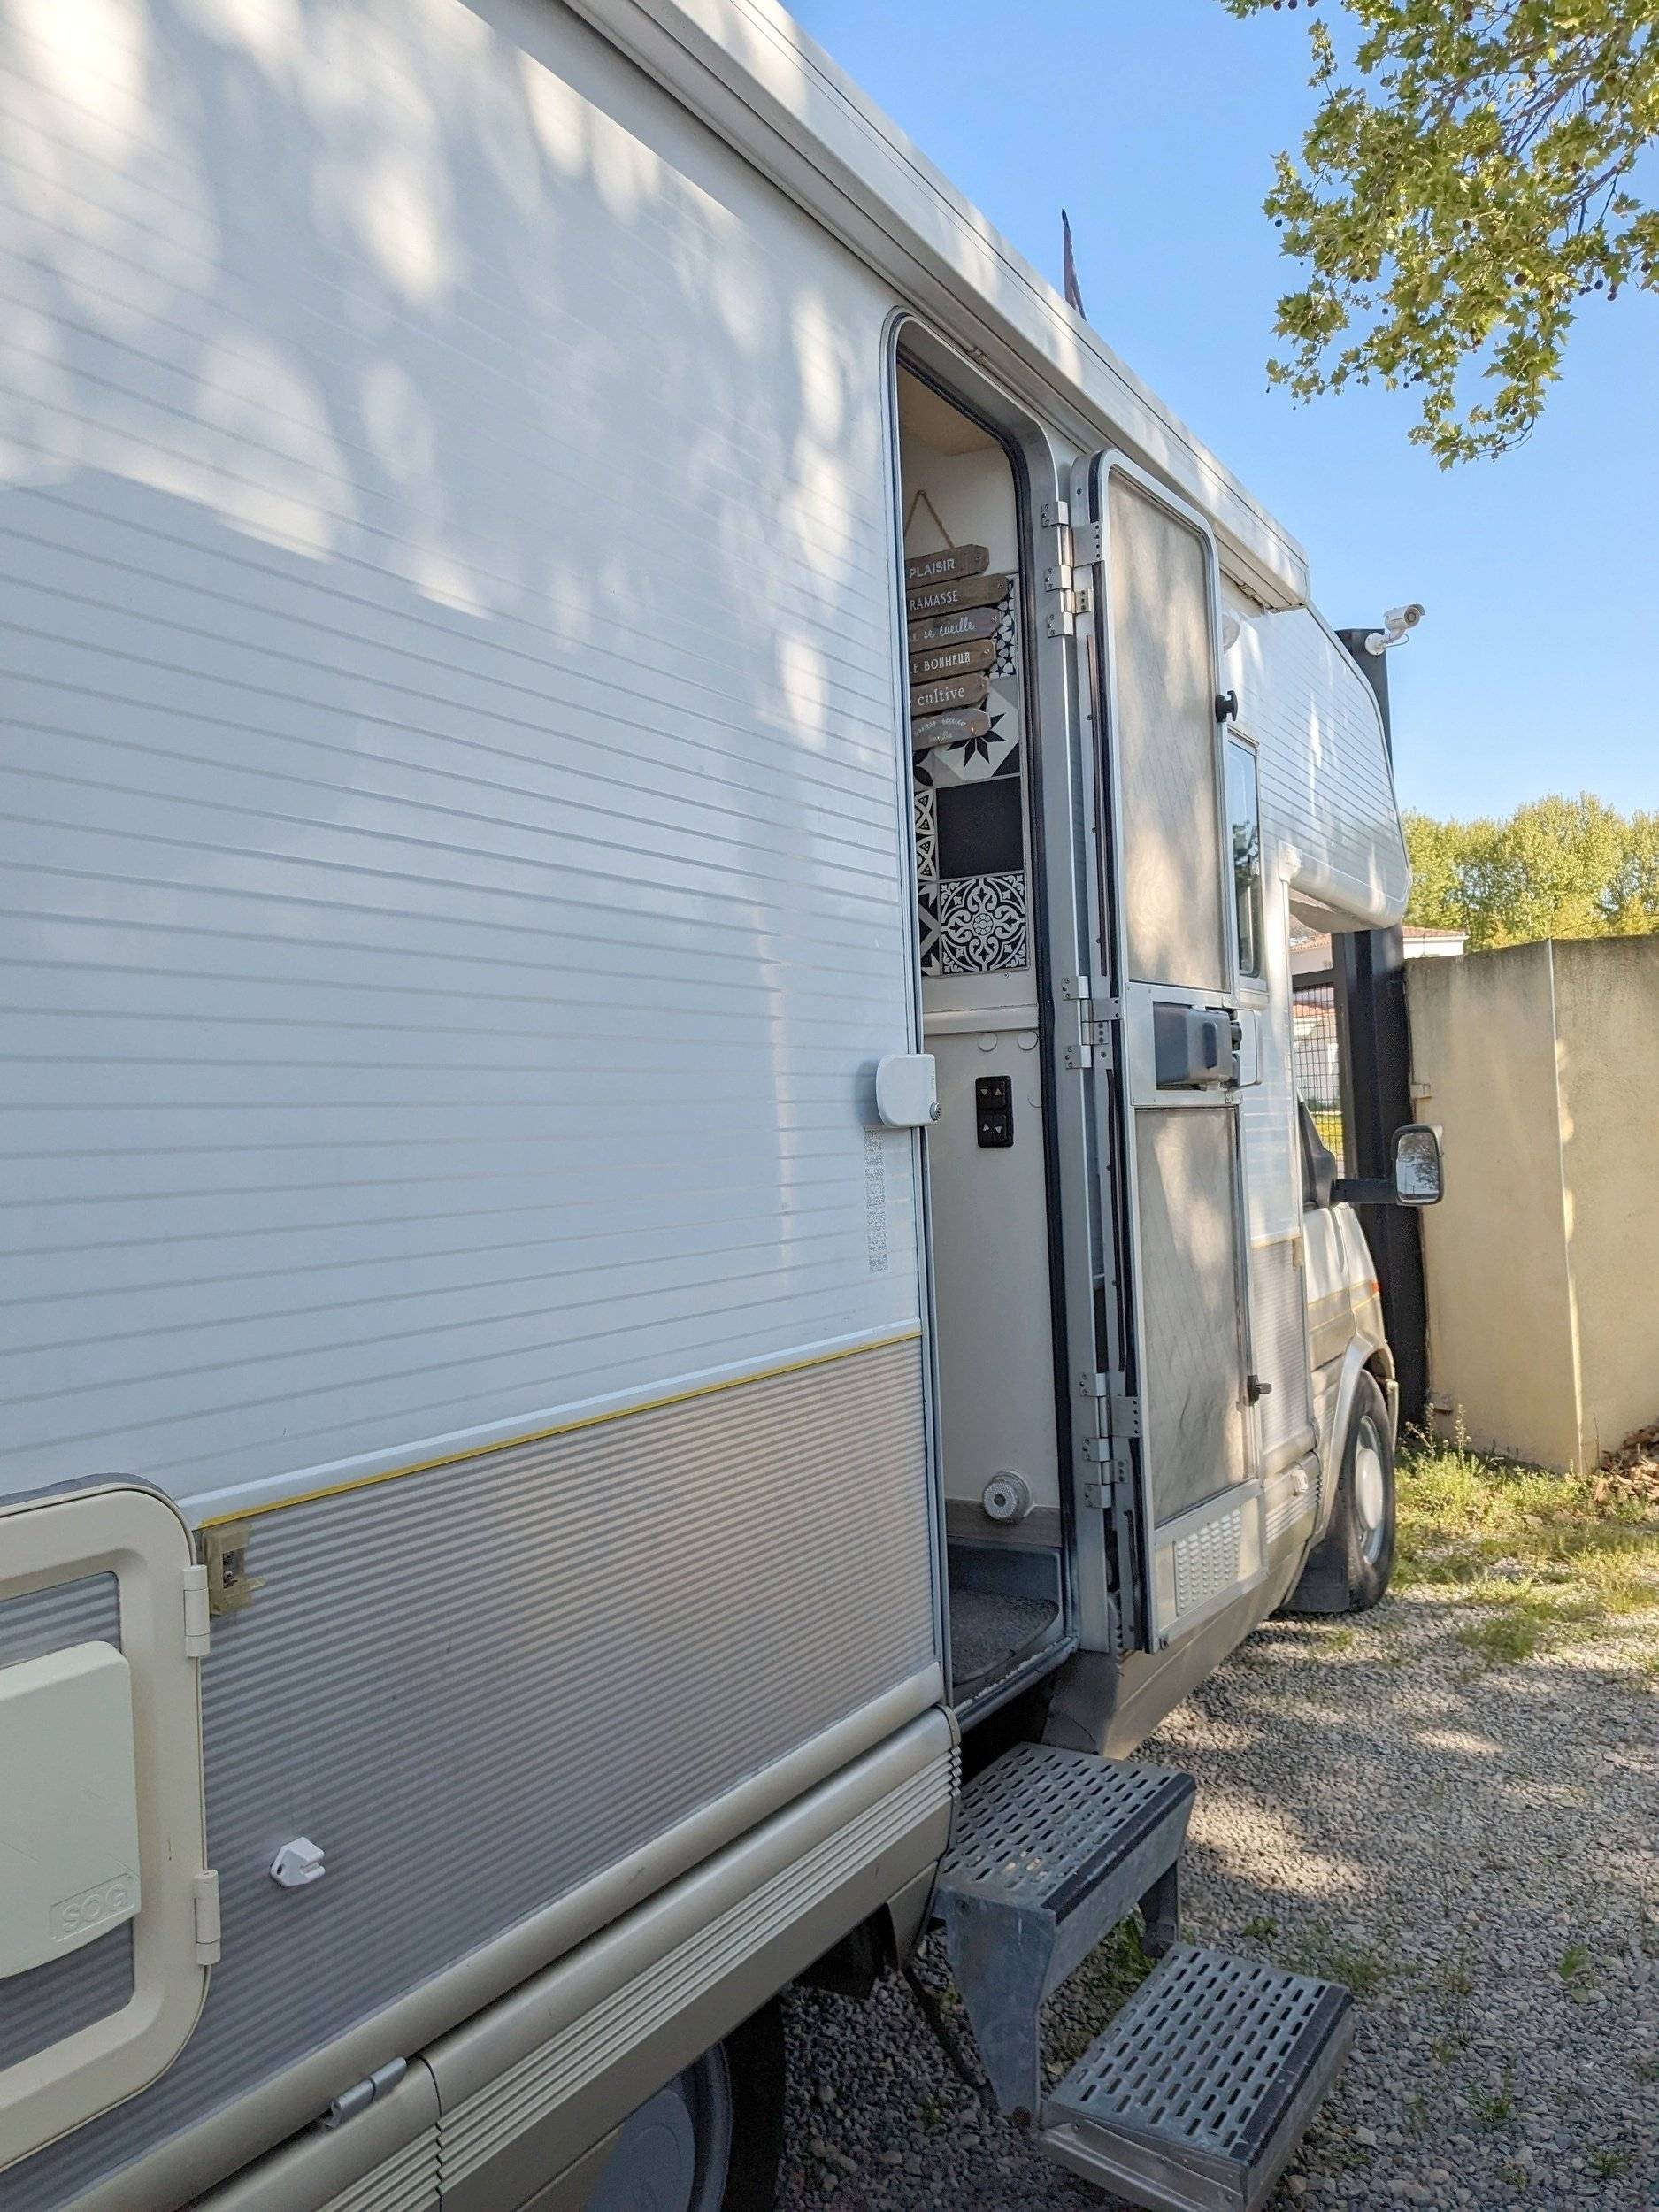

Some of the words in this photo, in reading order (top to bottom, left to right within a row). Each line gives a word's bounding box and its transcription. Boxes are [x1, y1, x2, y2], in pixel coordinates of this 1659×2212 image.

[910, 558, 956, 579] PLAISIR
[910, 589, 958, 611] RAMASSE
[923, 628, 935, 639] se
[939, 616, 976, 637] cueille
[924, 651, 971, 672] BONHEUR
[918, 687, 965, 706] cultive
[60, 1882, 130, 1932] SOG
